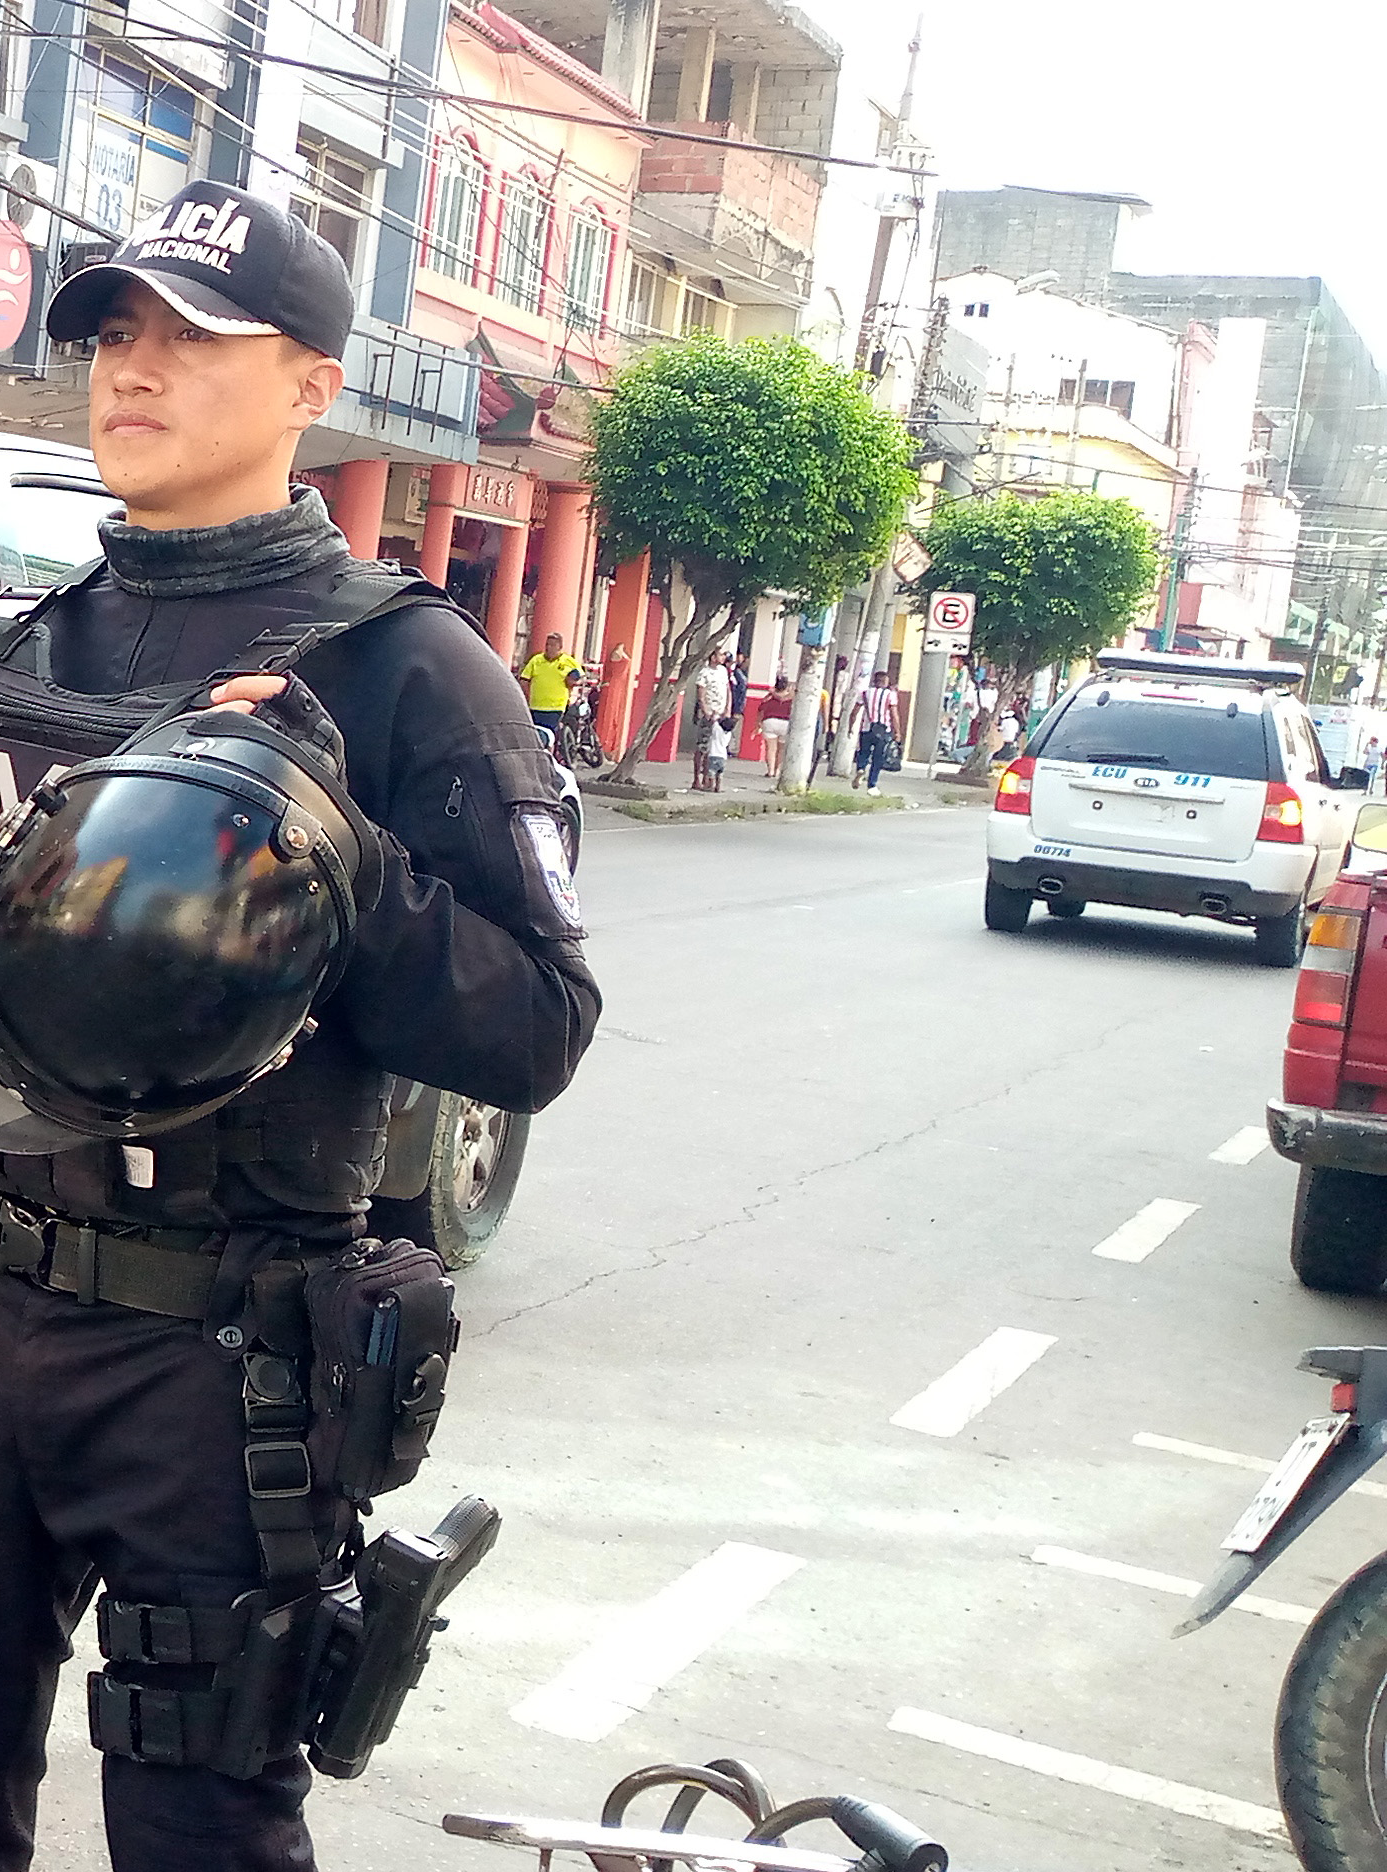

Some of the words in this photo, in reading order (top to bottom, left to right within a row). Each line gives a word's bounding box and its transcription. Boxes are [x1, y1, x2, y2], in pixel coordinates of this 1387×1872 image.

[92, 144, 136, 188] NOTARÍA
[97, 183, 122, 232] 03
[135, 239, 232, 275] NACIONAL
[1091, 766, 1127, 779] ECU
[1173, 773, 1212, 788] 911
